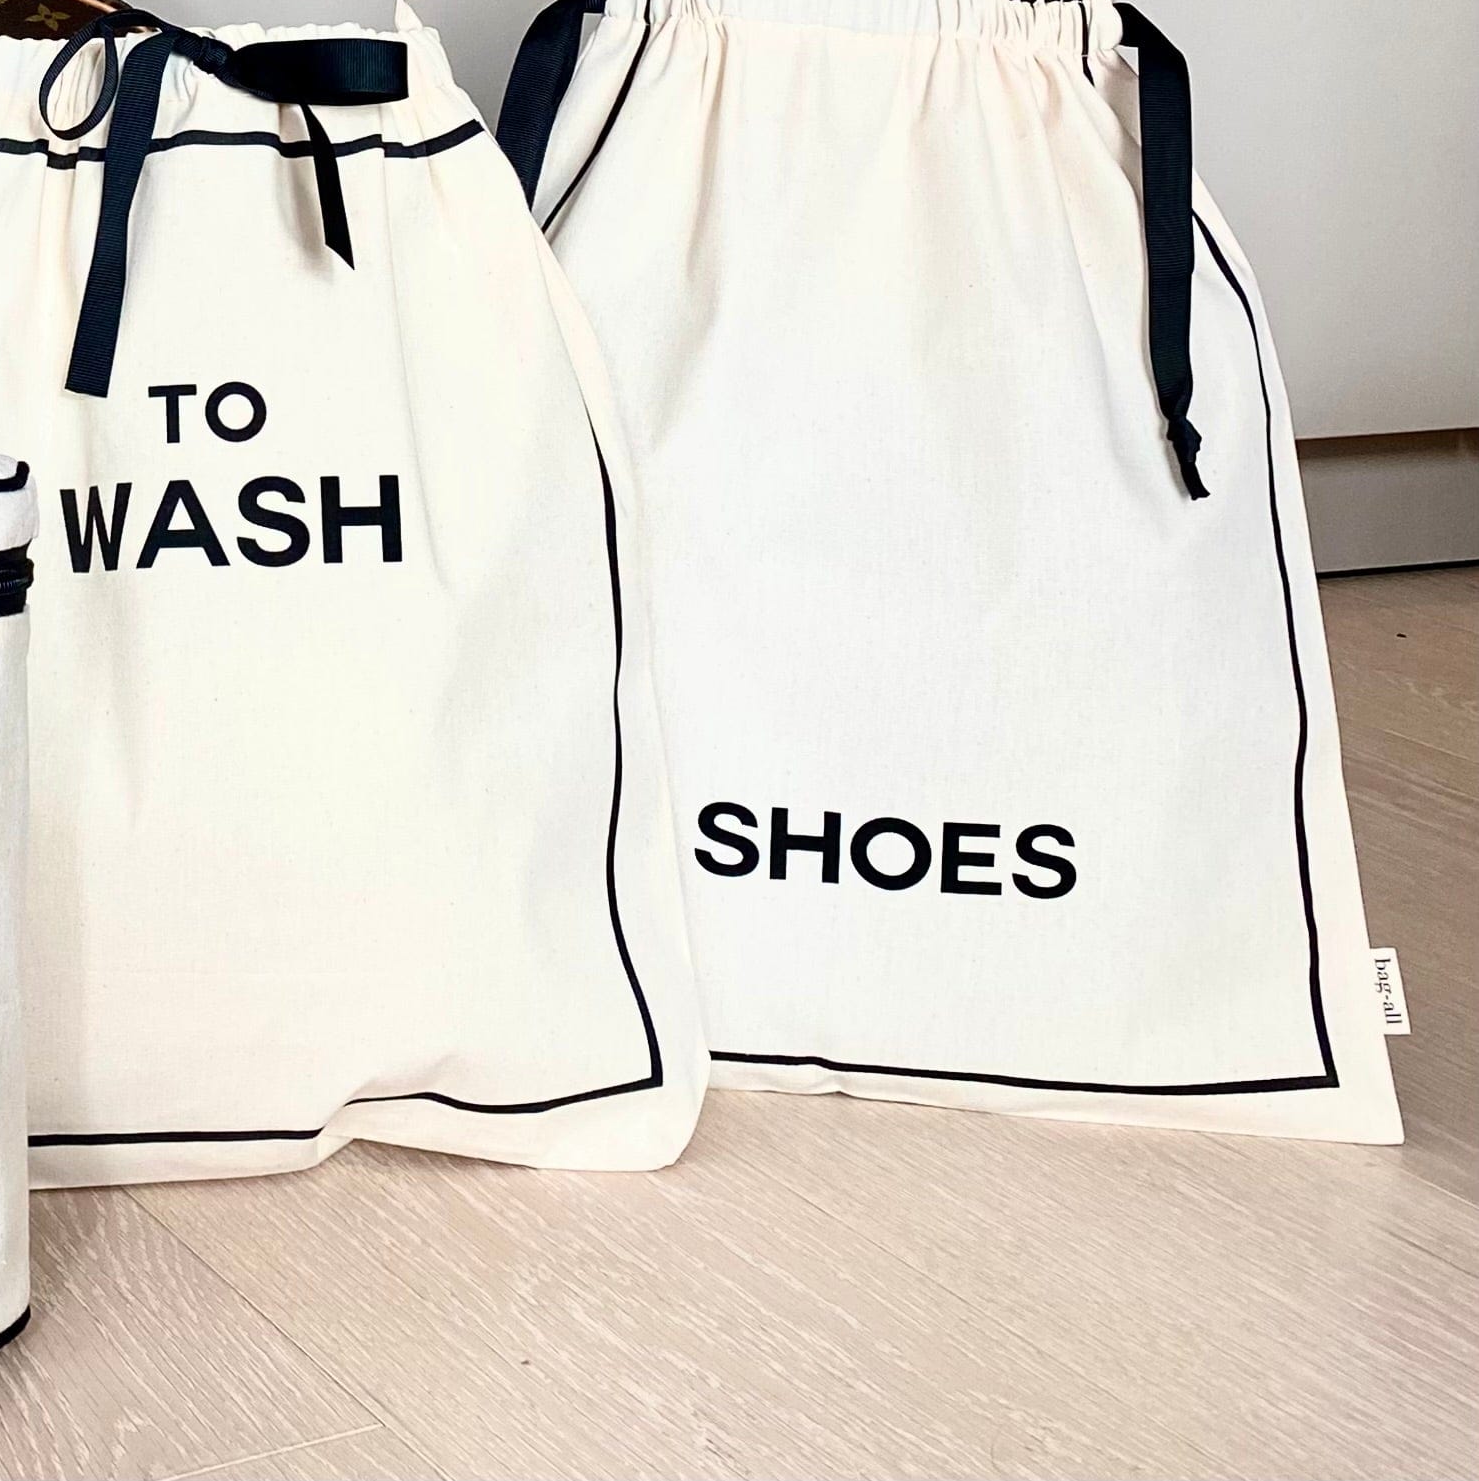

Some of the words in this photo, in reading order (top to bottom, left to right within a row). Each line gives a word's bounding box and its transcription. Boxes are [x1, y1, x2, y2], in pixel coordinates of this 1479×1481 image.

[147, 381, 268, 444] TO
[59, 474, 404, 575] WASH
[694, 801, 1079, 901] SHOES
[1374, 957, 1403, 1024] bag-all
